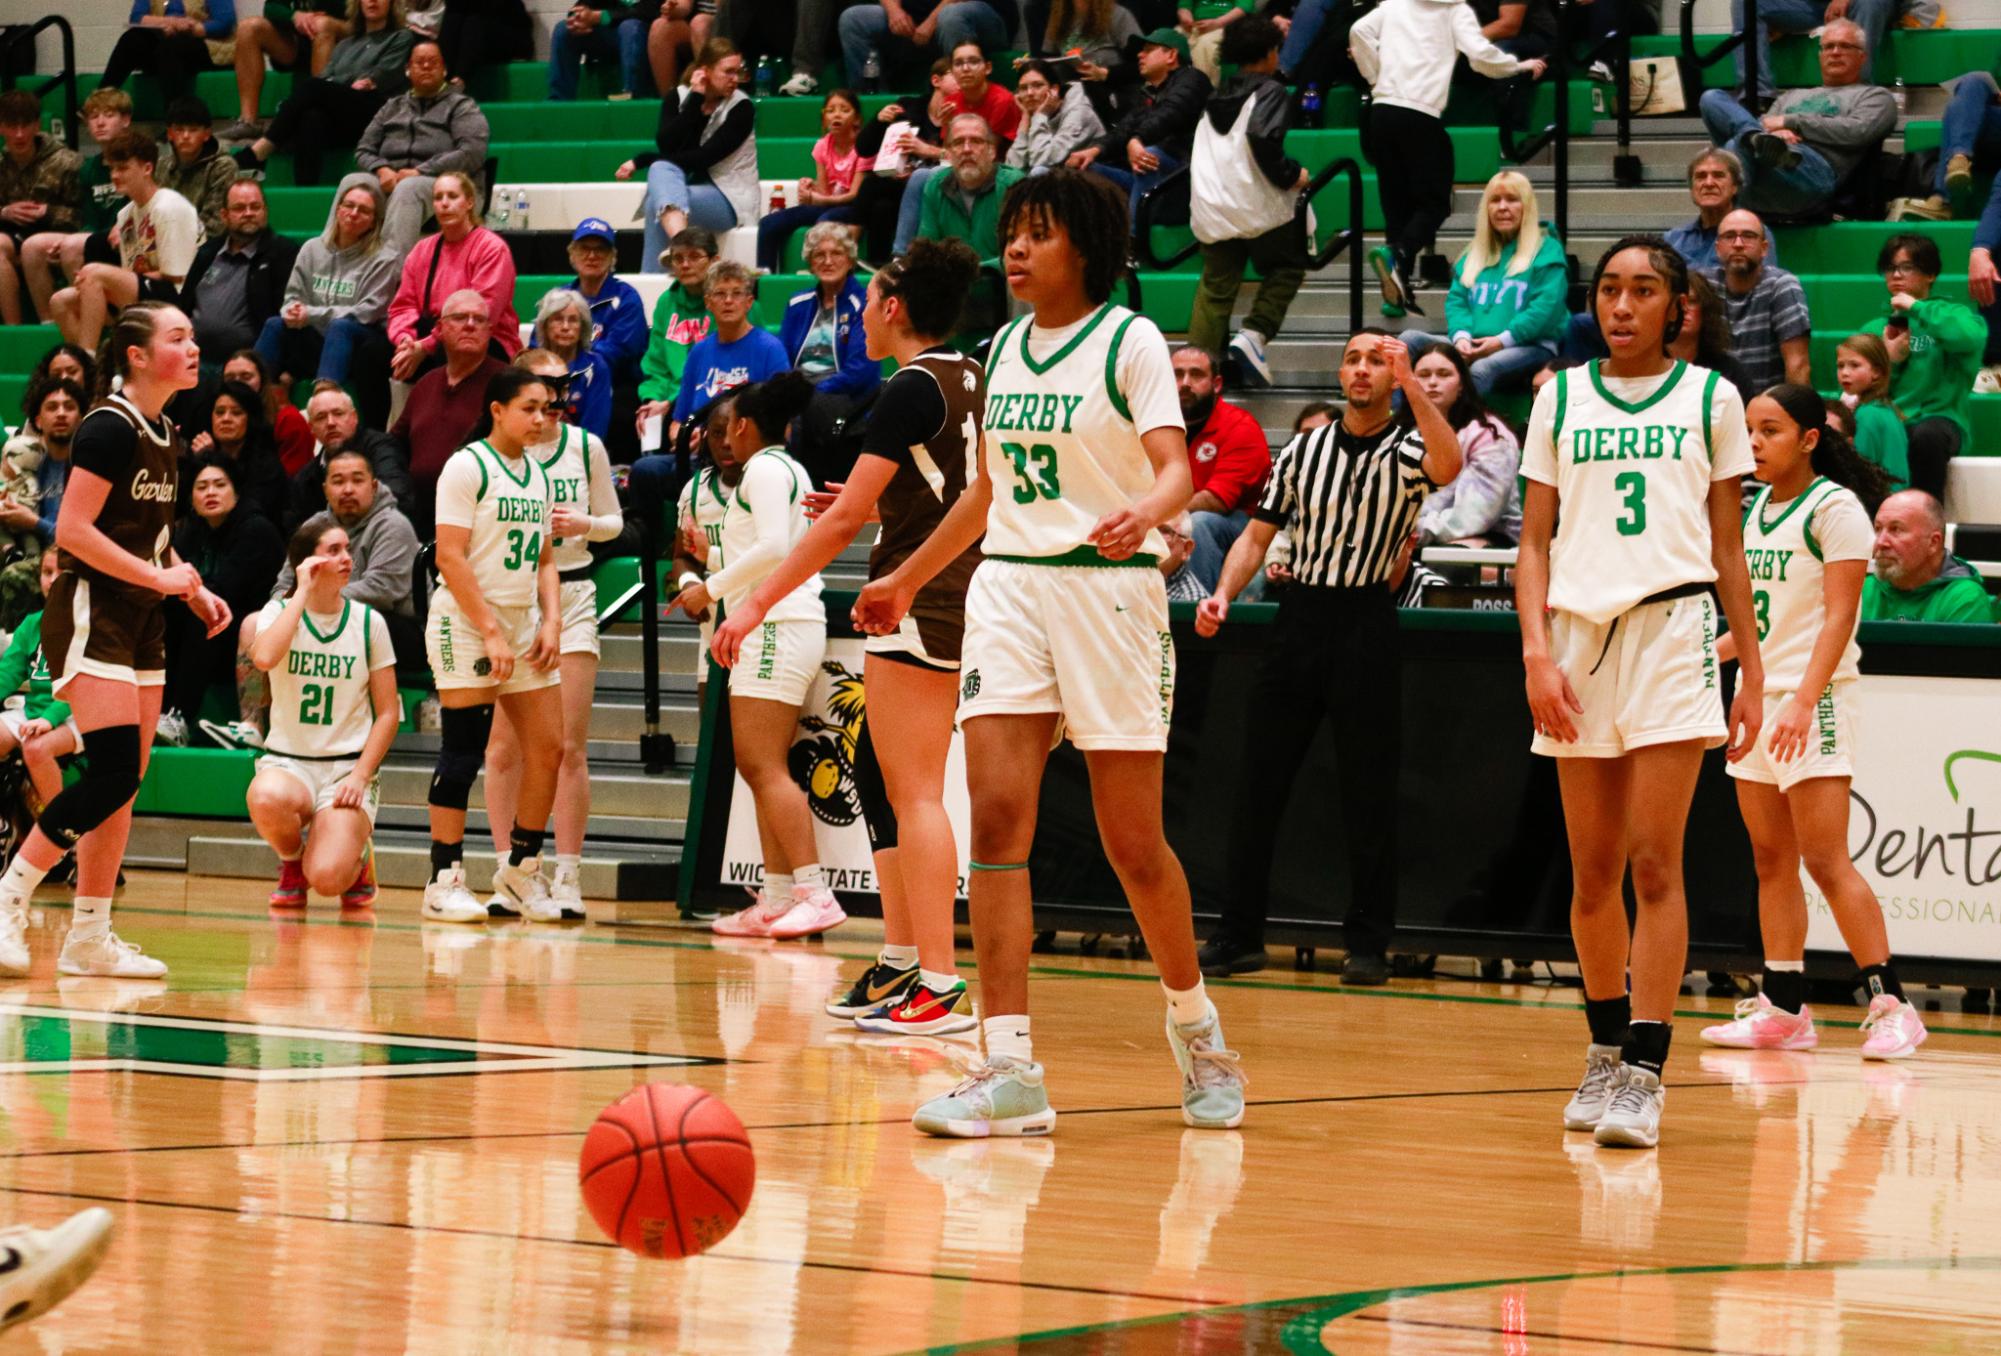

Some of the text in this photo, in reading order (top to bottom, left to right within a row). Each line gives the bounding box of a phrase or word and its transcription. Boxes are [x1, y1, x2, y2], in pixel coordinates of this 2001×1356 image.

[985, 393, 1084, 434] DERBY
[1573, 425, 1688, 465] DERBY
[1000, 442, 1061, 505] 33
[1615, 471, 1646, 536] 3
[504, 529, 541, 573] 34
[288, 650, 357, 680] DERBY
[757, 622, 776, 680] PANTHERS
[299, 683, 335, 726] 21
[838, 774, 863, 816] WSU
